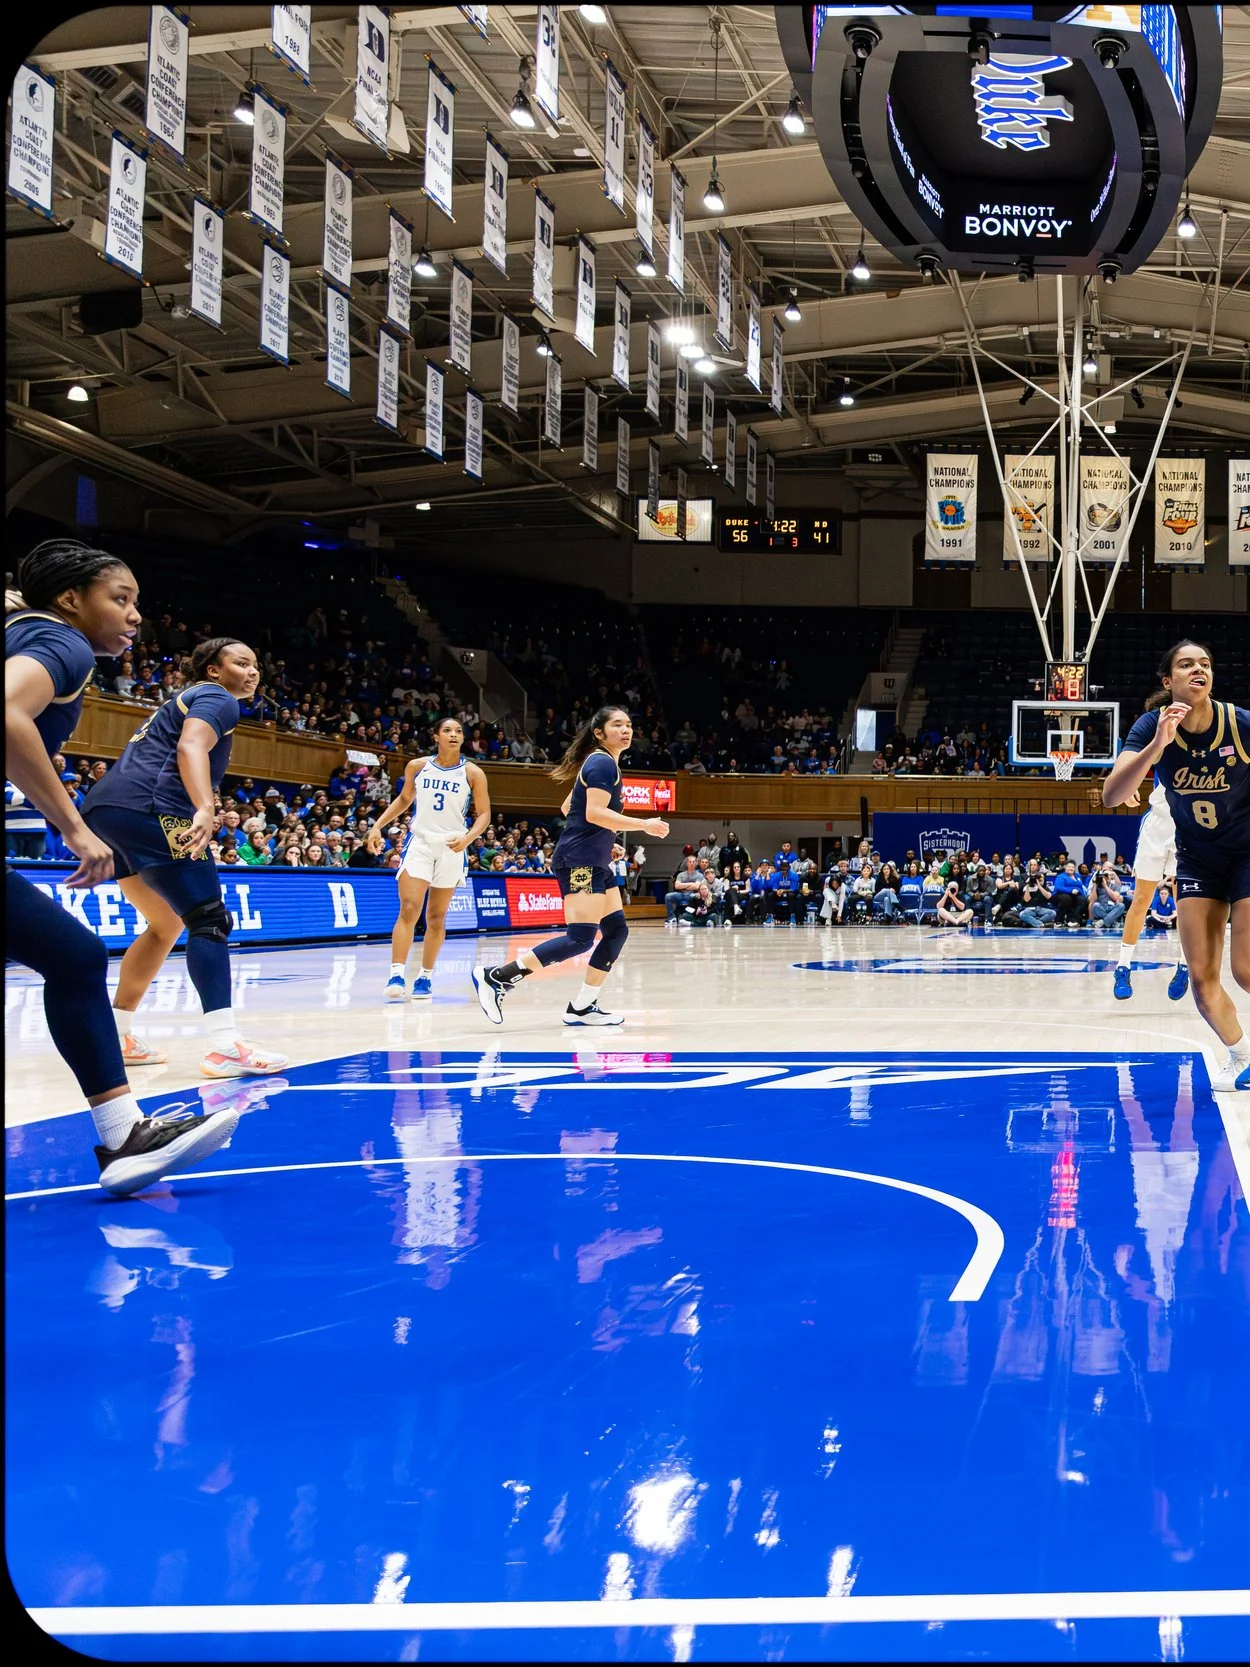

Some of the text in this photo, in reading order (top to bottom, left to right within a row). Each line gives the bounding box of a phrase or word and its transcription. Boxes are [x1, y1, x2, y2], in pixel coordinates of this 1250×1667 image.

[157, 55, 181, 81] ATLANTIC
[367, 65, 382, 86] NCAA
[160, 69, 178, 89] COAST
[151, 73, 185, 110] CONFERENCE
[152, 87, 184, 121] CHAMPIONS
[19, 115, 48, 140] ATLANTIC
[159, 121, 175, 141] 1964
[25, 131, 43, 148] COAST
[13, 135, 51, 166] CONFERENCE
[13, 148, 51, 178] CHAMPIONS
[254, 162, 284, 192] CONFERENCE
[23, 179, 40, 197] 2009
[255, 175, 283, 202] CHAMPIONS
[116, 187, 140, 211] ATLANTIC
[120, 203, 136, 218] COAST
[978, 203, 1056, 218] MARRIOTT
[110, 205, 144, 234] CONFERENCE
[964, 216, 1066, 239] BONVOY
[111, 217, 142, 244] CHAMPIONS
[117, 246, 134, 262] 2010
[933, 466, 972, 478] NATIONAL
[1087, 468, 1125, 479] NATIONAL
[1162, 471, 1199, 481] NATIONAL
[929, 478, 976, 490] CHAMPIONS
[1082, 480, 1128, 491] CHAMPIONS
[1158, 482, 1204, 493] CHAMPIONS
[1173, 501, 1199, 512] FINAL
[725, 518, 749, 527] DUKE
[1163, 509, 1199, 522] FOUR
[732, 529, 749, 543] 56
[792, 536, 799, 548] 3
[813, 531, 830, 544] 41
[940, 538, 963, 548] 1991
[1093, 540, 1116, 550] 2001
[1169, 541, 1193, 552] 2010
[1057, 666, 1085, 679] 4:22
[422, 778, 461, 794] DUKE
[1171, 765, 1232, 795] Irish
[433, 792, 445, 812] 3
[627, 796, 651, 805] WORK
[1191, 799, 1220, 831] 8
[923, 838, 966, 851] SISTERHOOD
